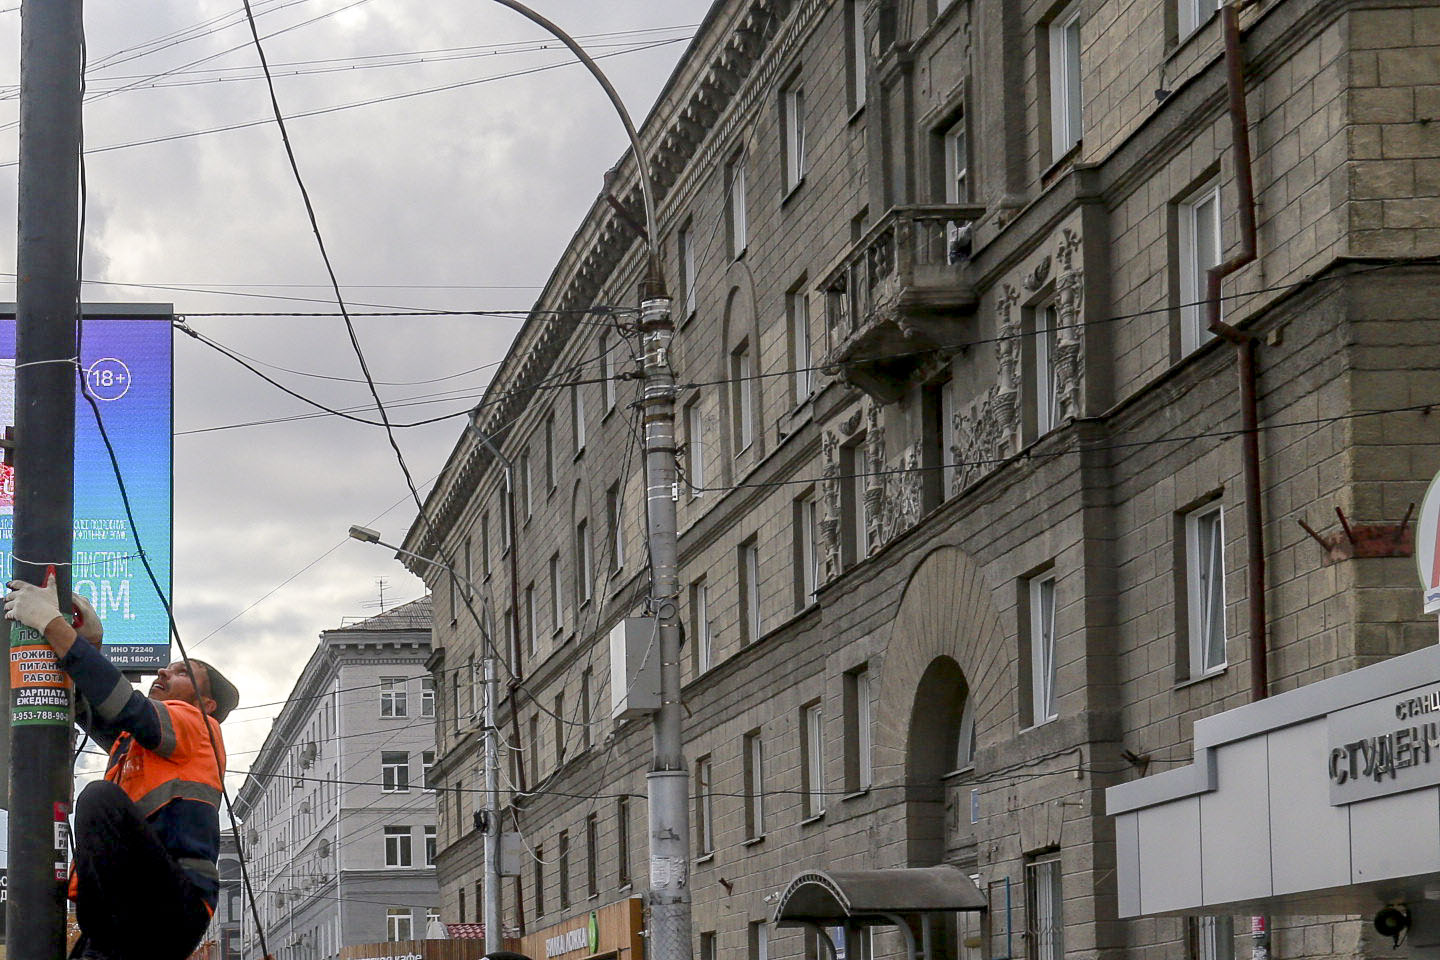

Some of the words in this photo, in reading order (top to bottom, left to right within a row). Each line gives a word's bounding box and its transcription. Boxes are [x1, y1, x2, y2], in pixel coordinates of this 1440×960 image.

[92, 370, 126, 387] 18+
[110, 655, 129, 664] ИНД
[23, 673, 65, 683] РАБОТА
[20, 687, 67, 699] ЗАРПЛАТА
[16, 696, 69, 707] ЕЖЕДНЕВНО
